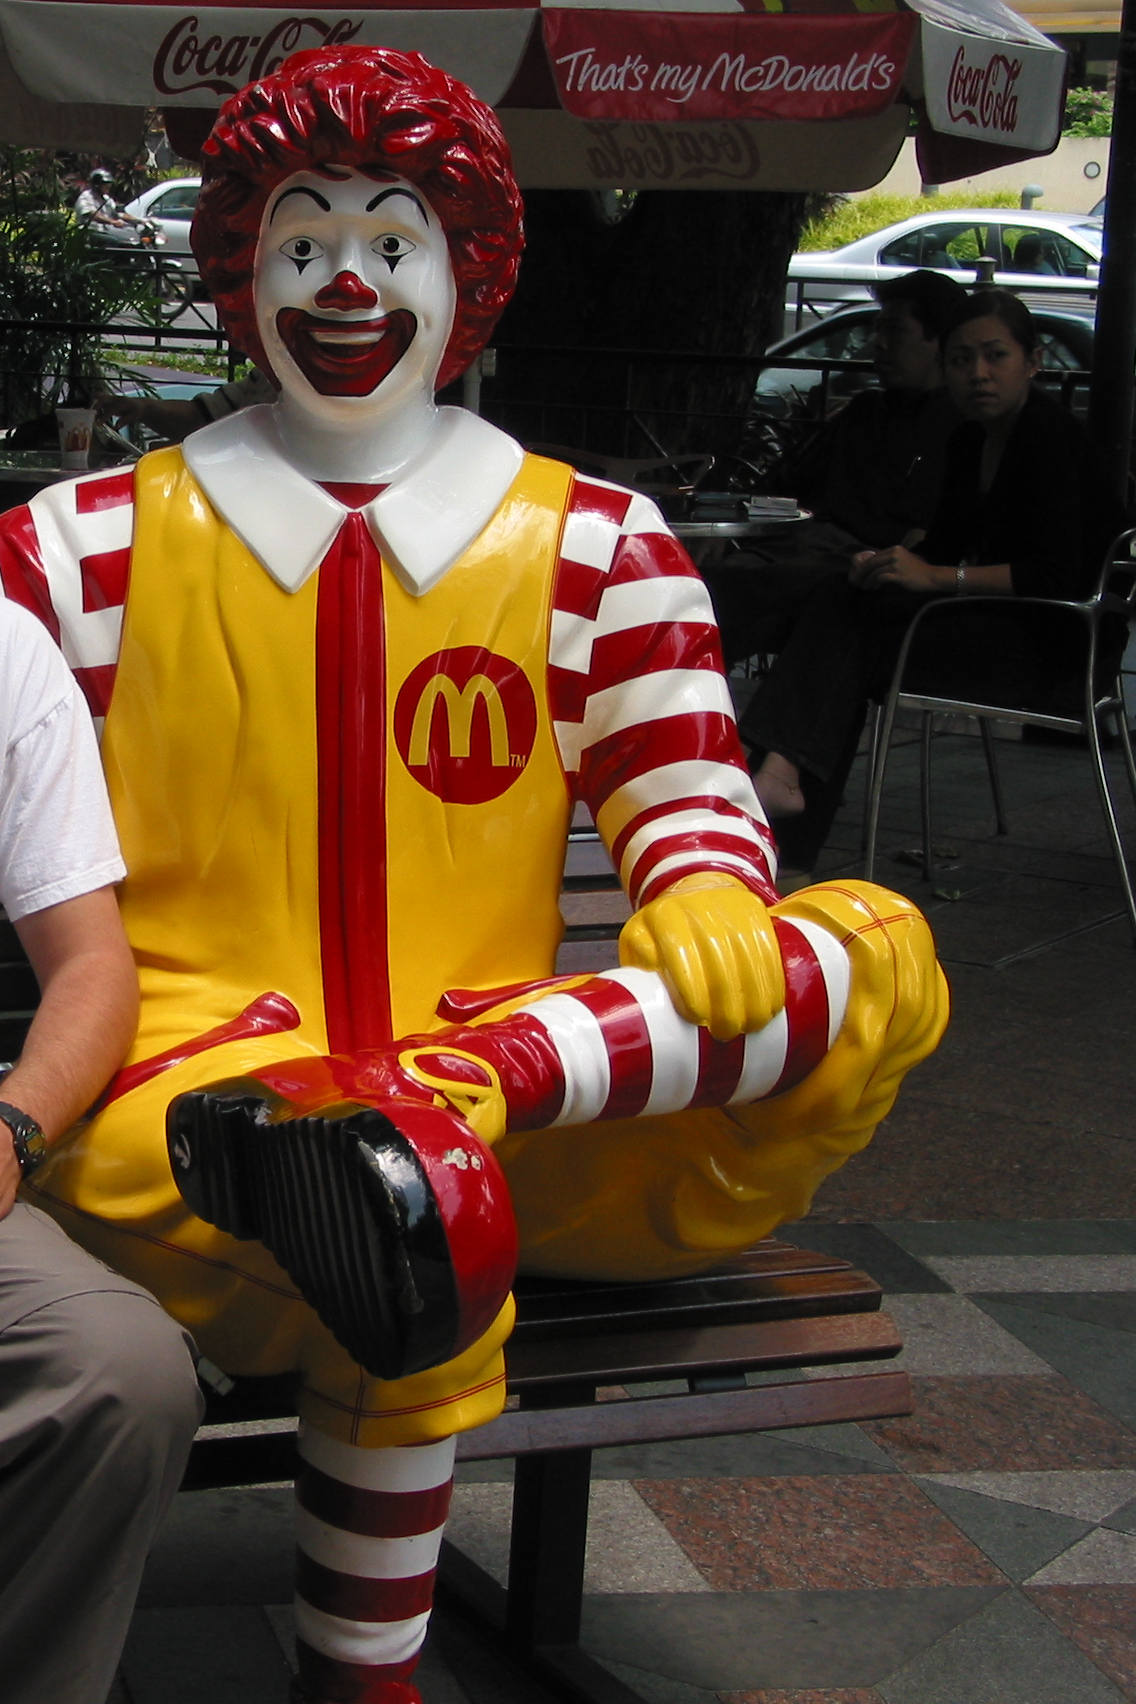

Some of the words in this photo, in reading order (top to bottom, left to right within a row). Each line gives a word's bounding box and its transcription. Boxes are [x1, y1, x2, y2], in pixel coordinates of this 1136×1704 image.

[152, 15, 365, 95] Coca-C
[555, 47, 649, 92] That's
[650, 62, 702, 103] my
[700, 52, 895, 92] McDonald's
[947, 45, 1023, 132] Coca-Cola
